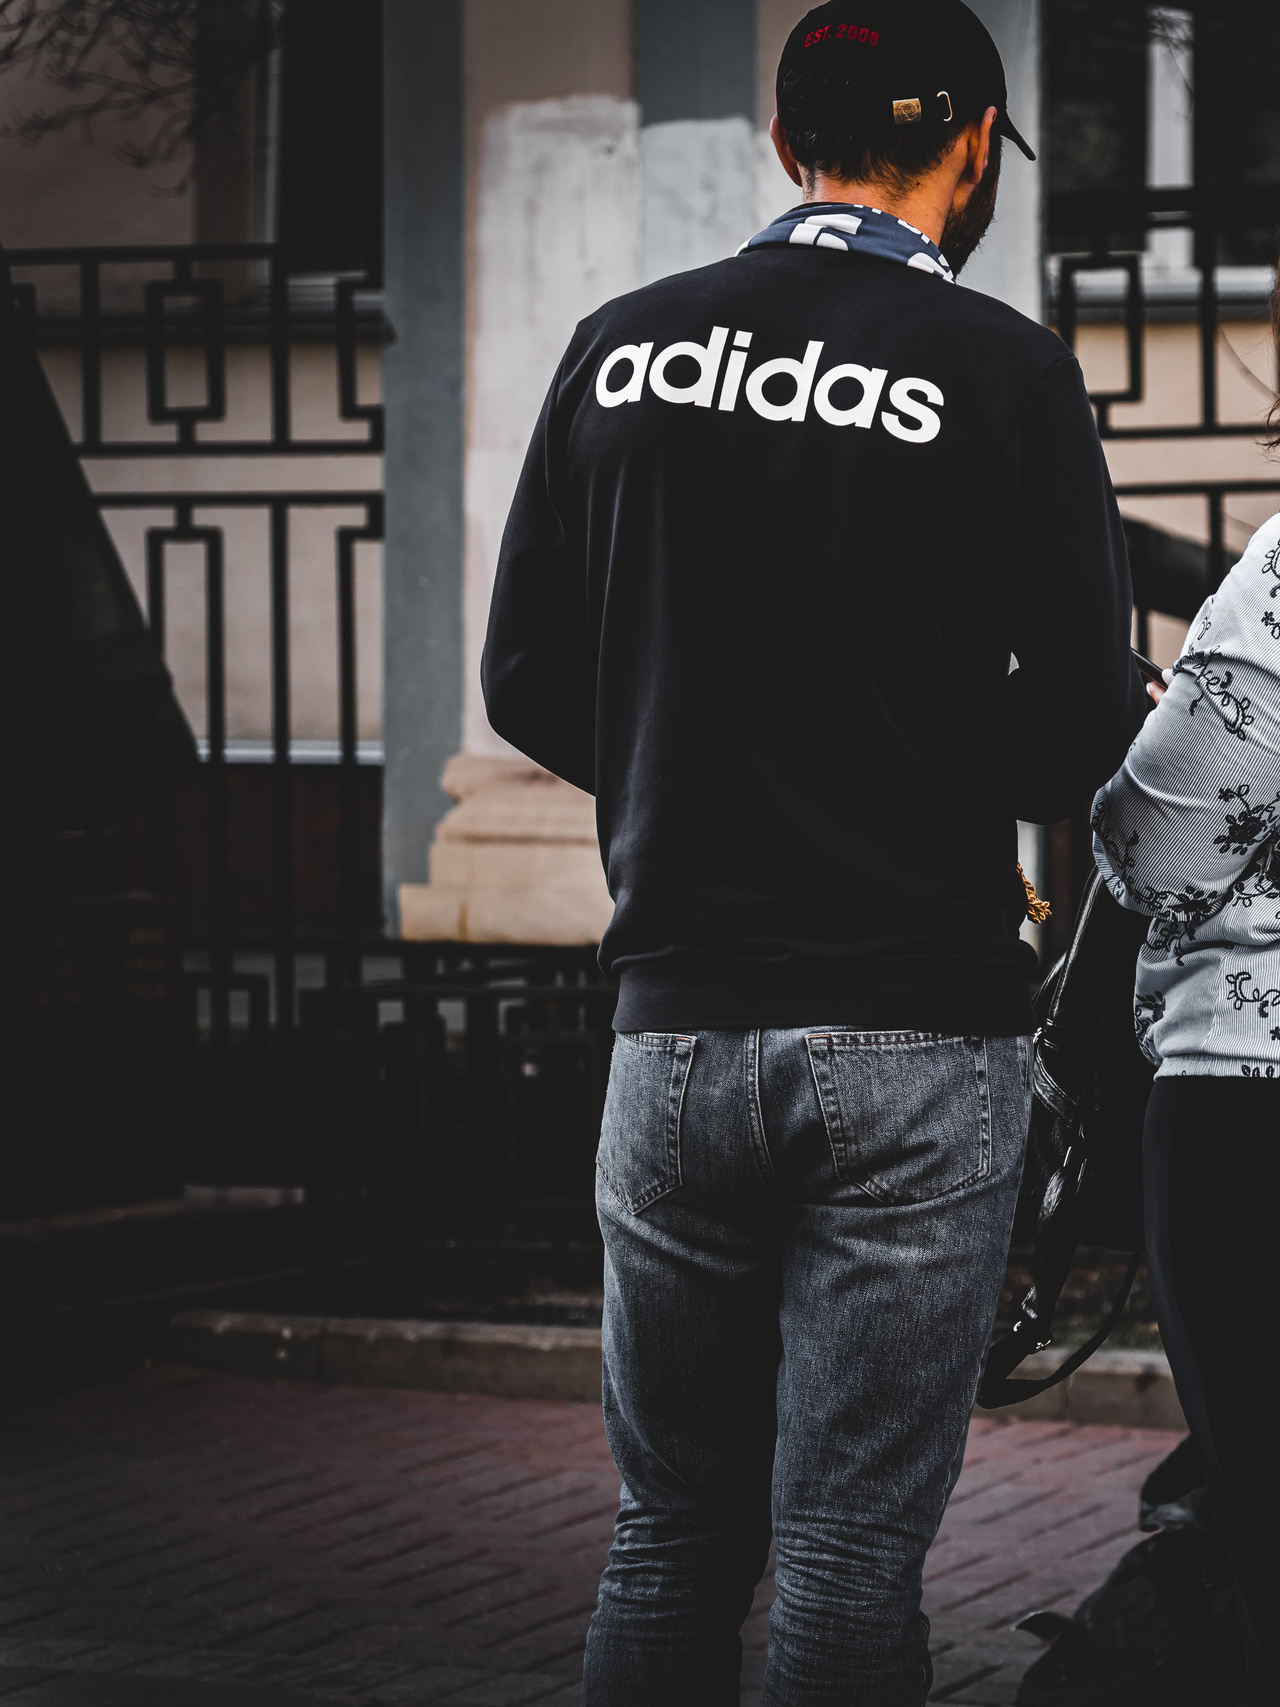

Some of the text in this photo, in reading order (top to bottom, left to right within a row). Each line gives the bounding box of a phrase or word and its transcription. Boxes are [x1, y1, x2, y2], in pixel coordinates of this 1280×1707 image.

[804, 23, 880, 48] EST. 2008
[594, 325, 946, 445] adidas
